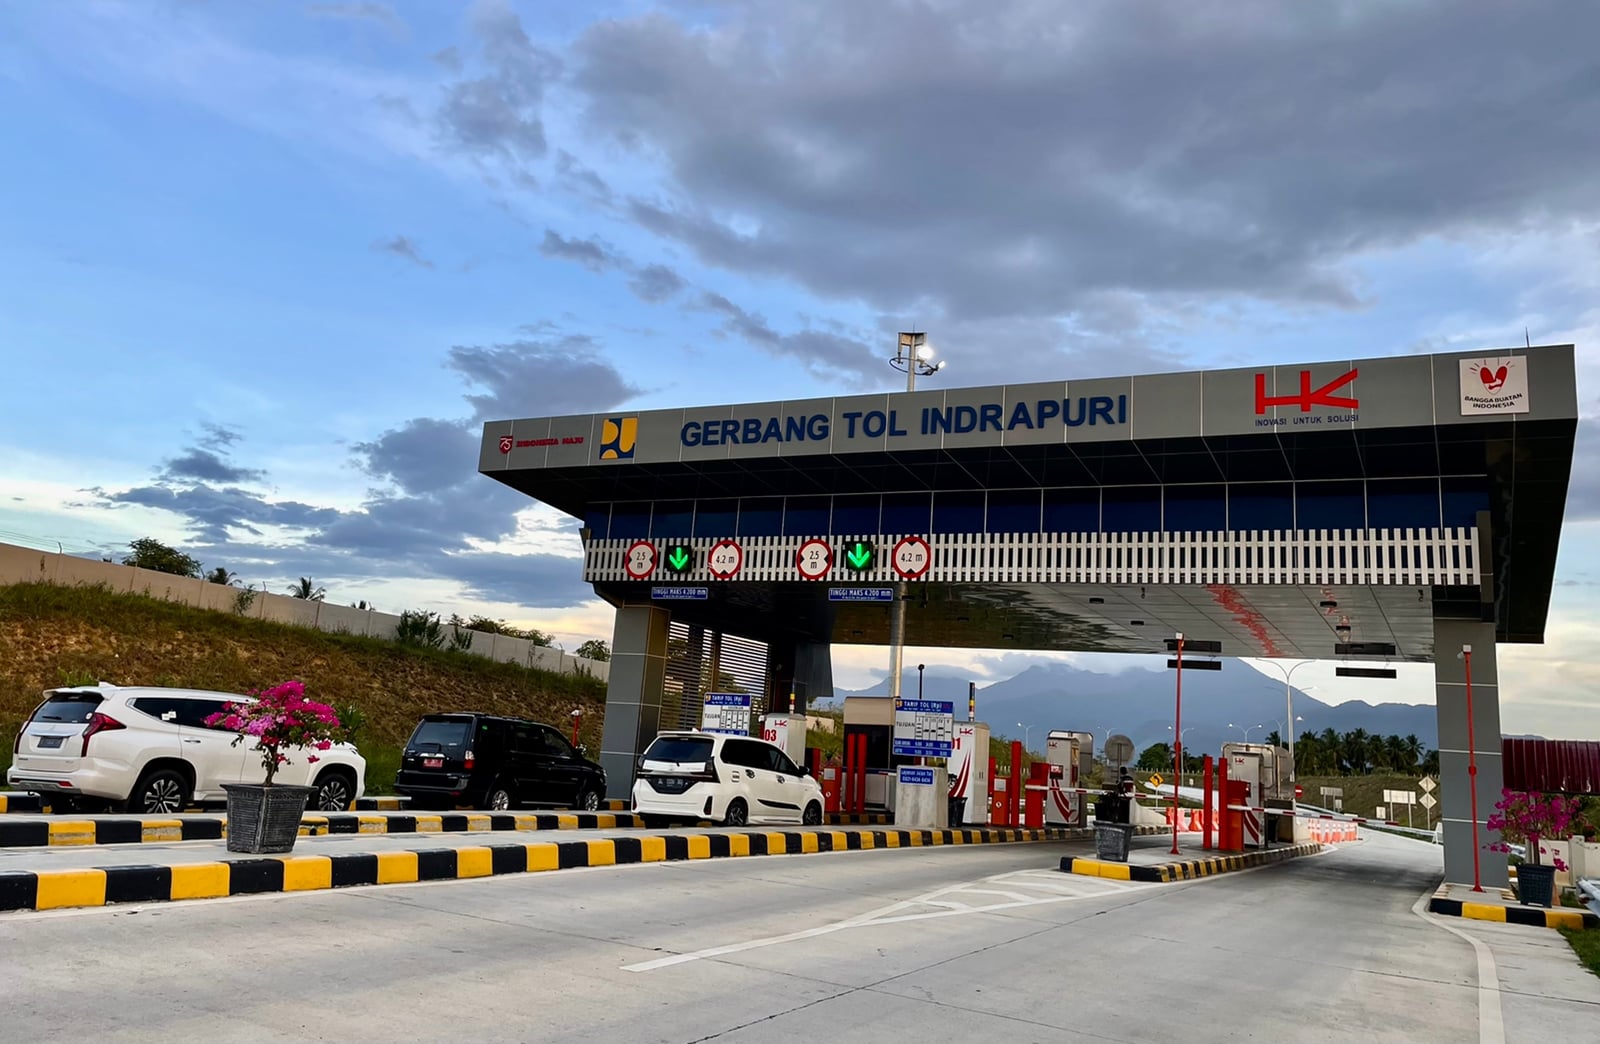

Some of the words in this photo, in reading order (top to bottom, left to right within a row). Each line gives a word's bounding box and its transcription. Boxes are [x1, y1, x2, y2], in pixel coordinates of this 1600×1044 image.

[1255, 368, 1359, 415] HK
[1464, 395, 1494, 403] BANGGA
[1494, 393, 1523, 402] BUATAN
[1473, 401, 1515, 409] INDONESIA
[681, 414, 829, 447] GERBANG
[842, 410, 907, 438] TOL
[921, 395, 1127, 434] INDRAPURI
[1255, 418, 1287, 427] INOVASI
[1293, 416, 1322, 425] UNTUK
[1327, 415, 1359, 423] SOLUSI
[516, 438, 559, 448] INDONESIA
[562, 437, 584, 445] MAJU
[637, 552, 646, 560] 2.5
[716, 555, 726, 564] 4.2
[810, 551, 819, 560] 2.5
[901, 553, 912, 562] 4.2
[915, 553, 923, 562] m
[810, 561, 817, 569] m
[765, 729, 777, 741] 03
